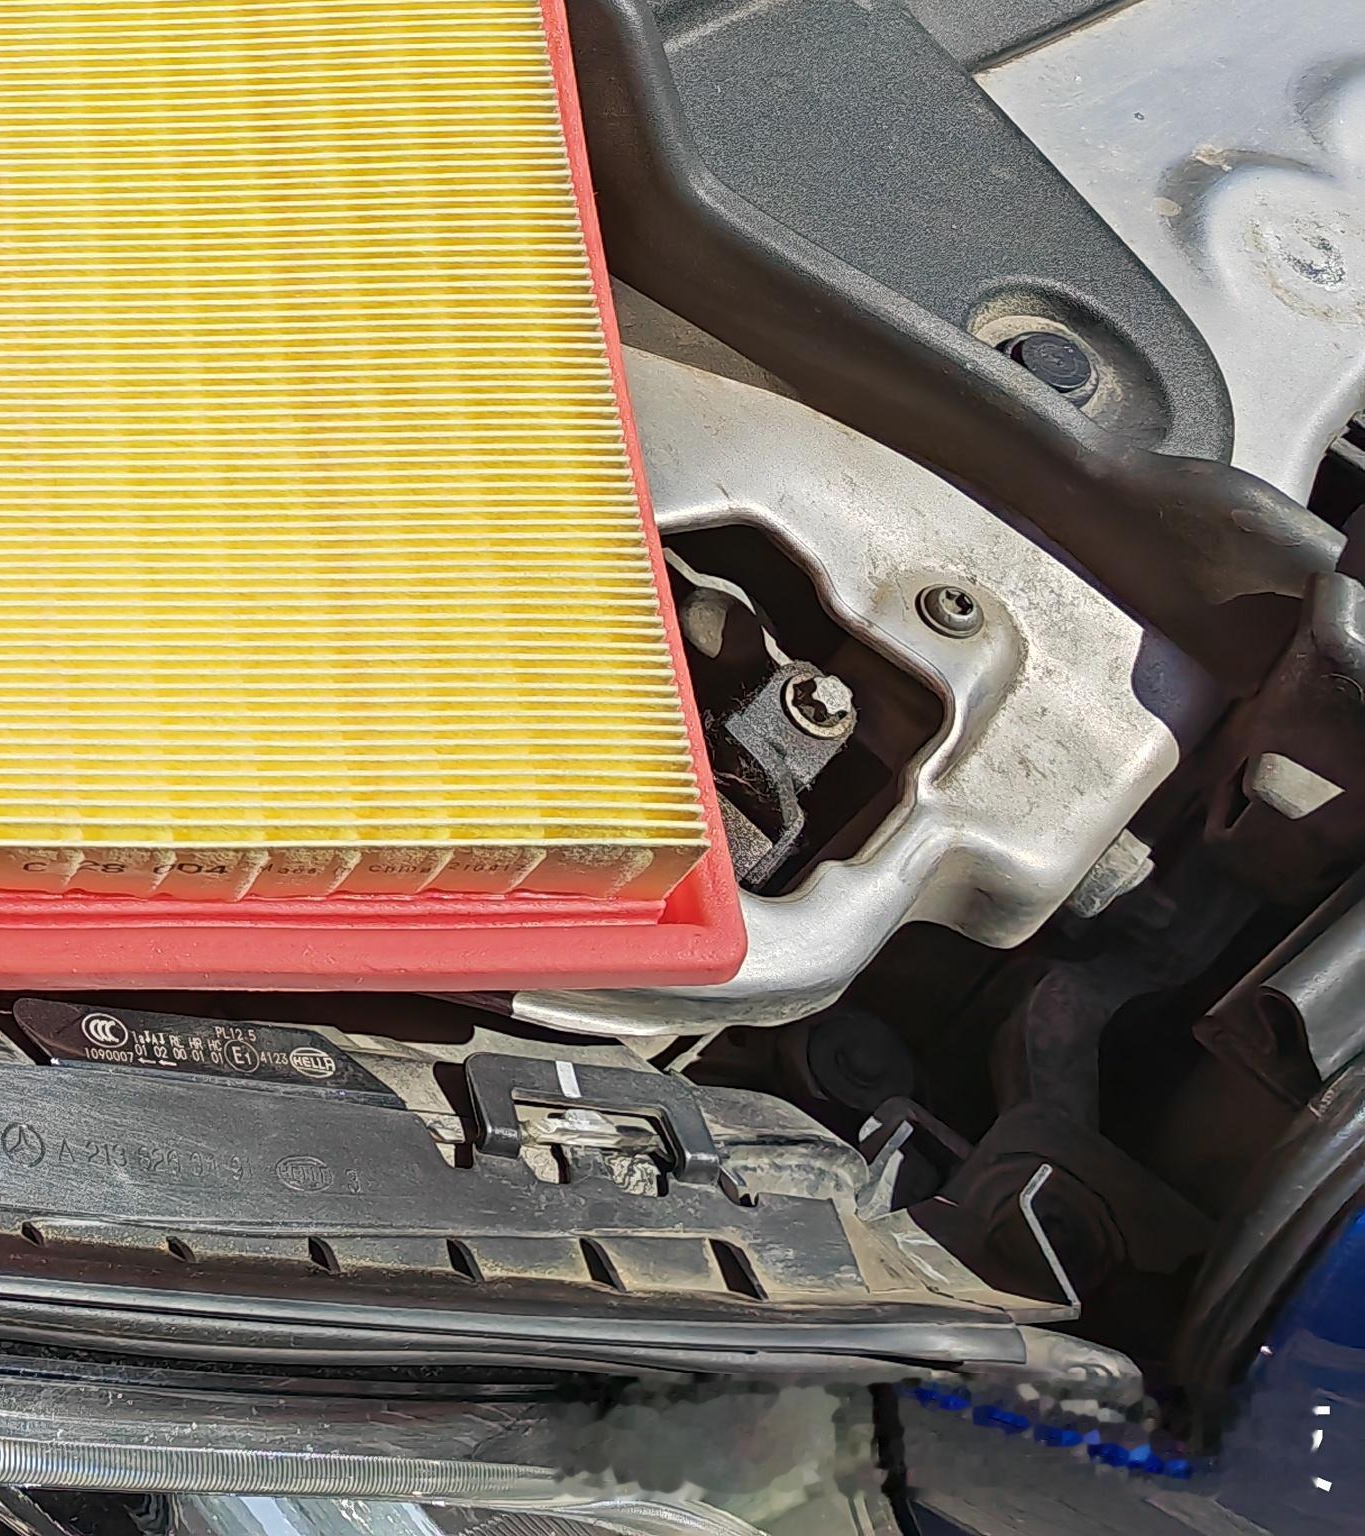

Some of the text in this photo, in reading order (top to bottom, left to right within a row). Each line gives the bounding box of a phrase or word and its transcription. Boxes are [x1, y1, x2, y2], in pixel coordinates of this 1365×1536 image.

[22, 862, 46, 873] C
[77, 860, 125, 874] 28
[189, 1037, 204, 1051] HR
[84, 1047, 134, 1063] 1090007
[135, 1045, 224, 1065] 01 02 00 01 01
[260, 1050, 289, 1065] 4123
[57, 1137, 76, 1164] A
[86, 1140, 128, 1168] 213
